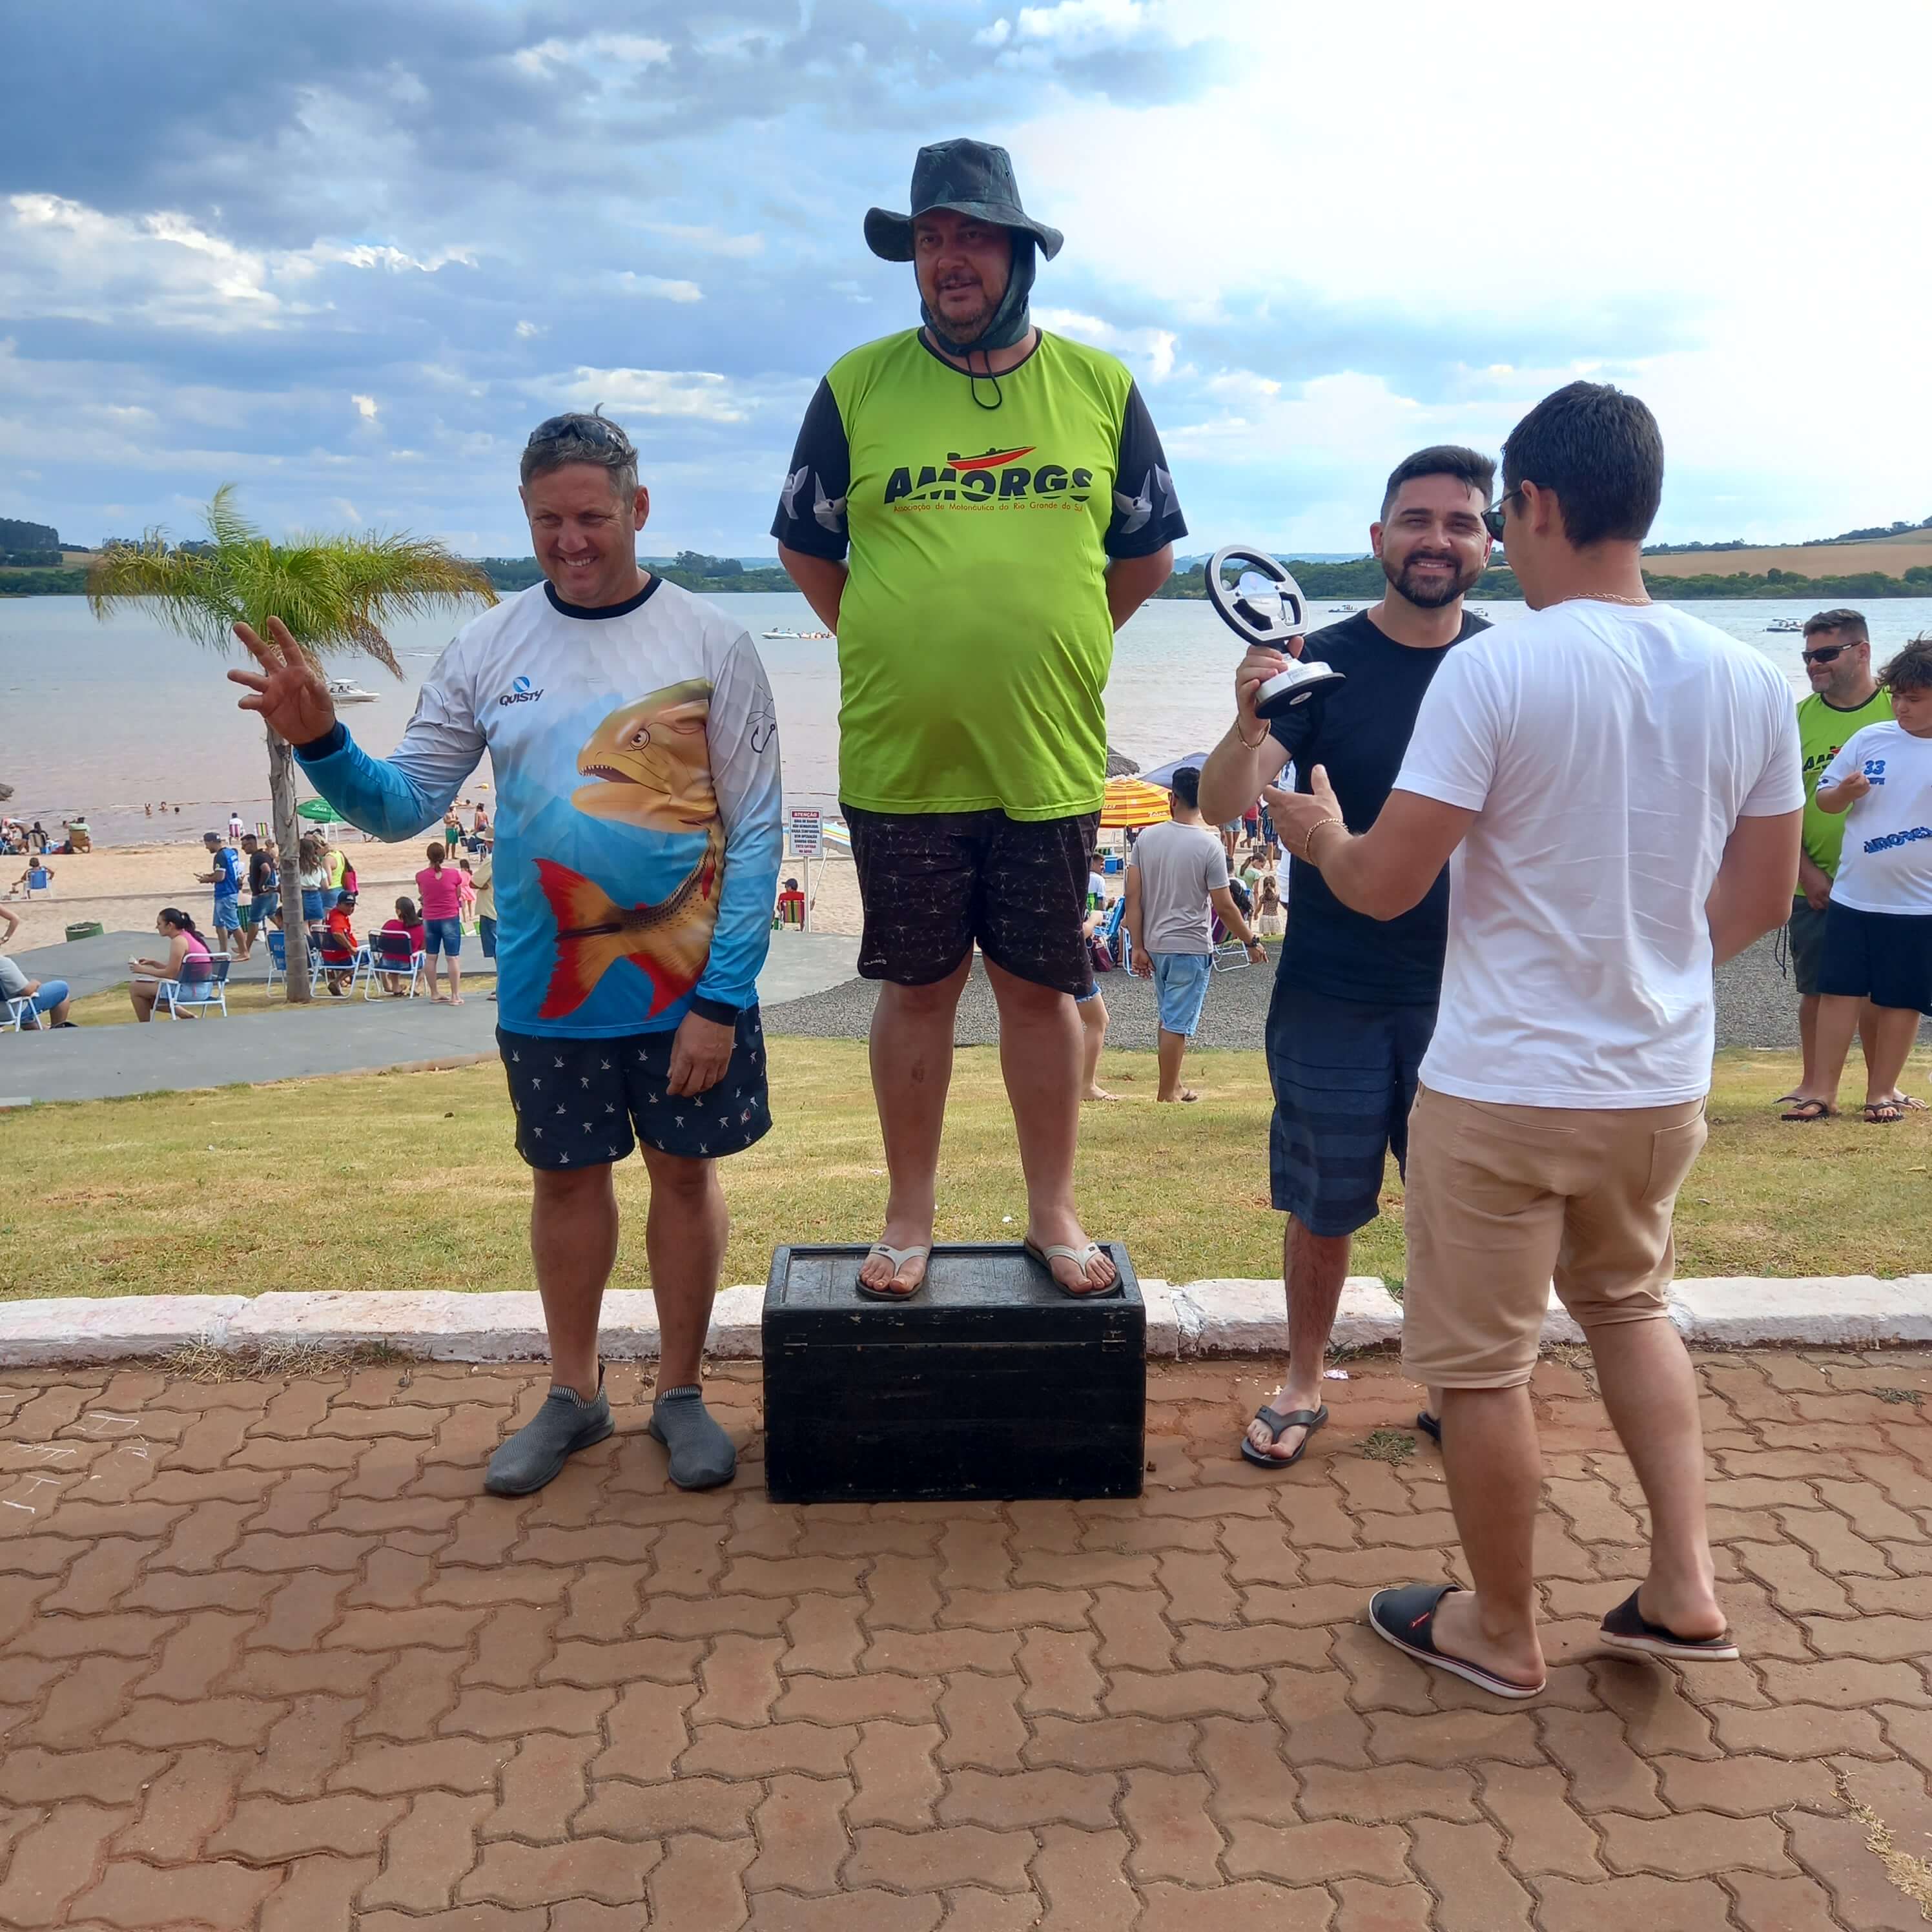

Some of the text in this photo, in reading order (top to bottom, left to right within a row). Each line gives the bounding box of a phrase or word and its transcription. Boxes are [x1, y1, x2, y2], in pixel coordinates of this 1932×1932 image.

[884, 465, 1093, 504] AMORGS
[894, 503, 930, 512] Associação
[1029, 501, 1058, 509] Grande
[1062, 502, 1071, 510] do
[1074, 503, 1084, 512] Sul
[499, 688, 544, 706] QUISTY
[1864, 760, 1886, 775] 33
